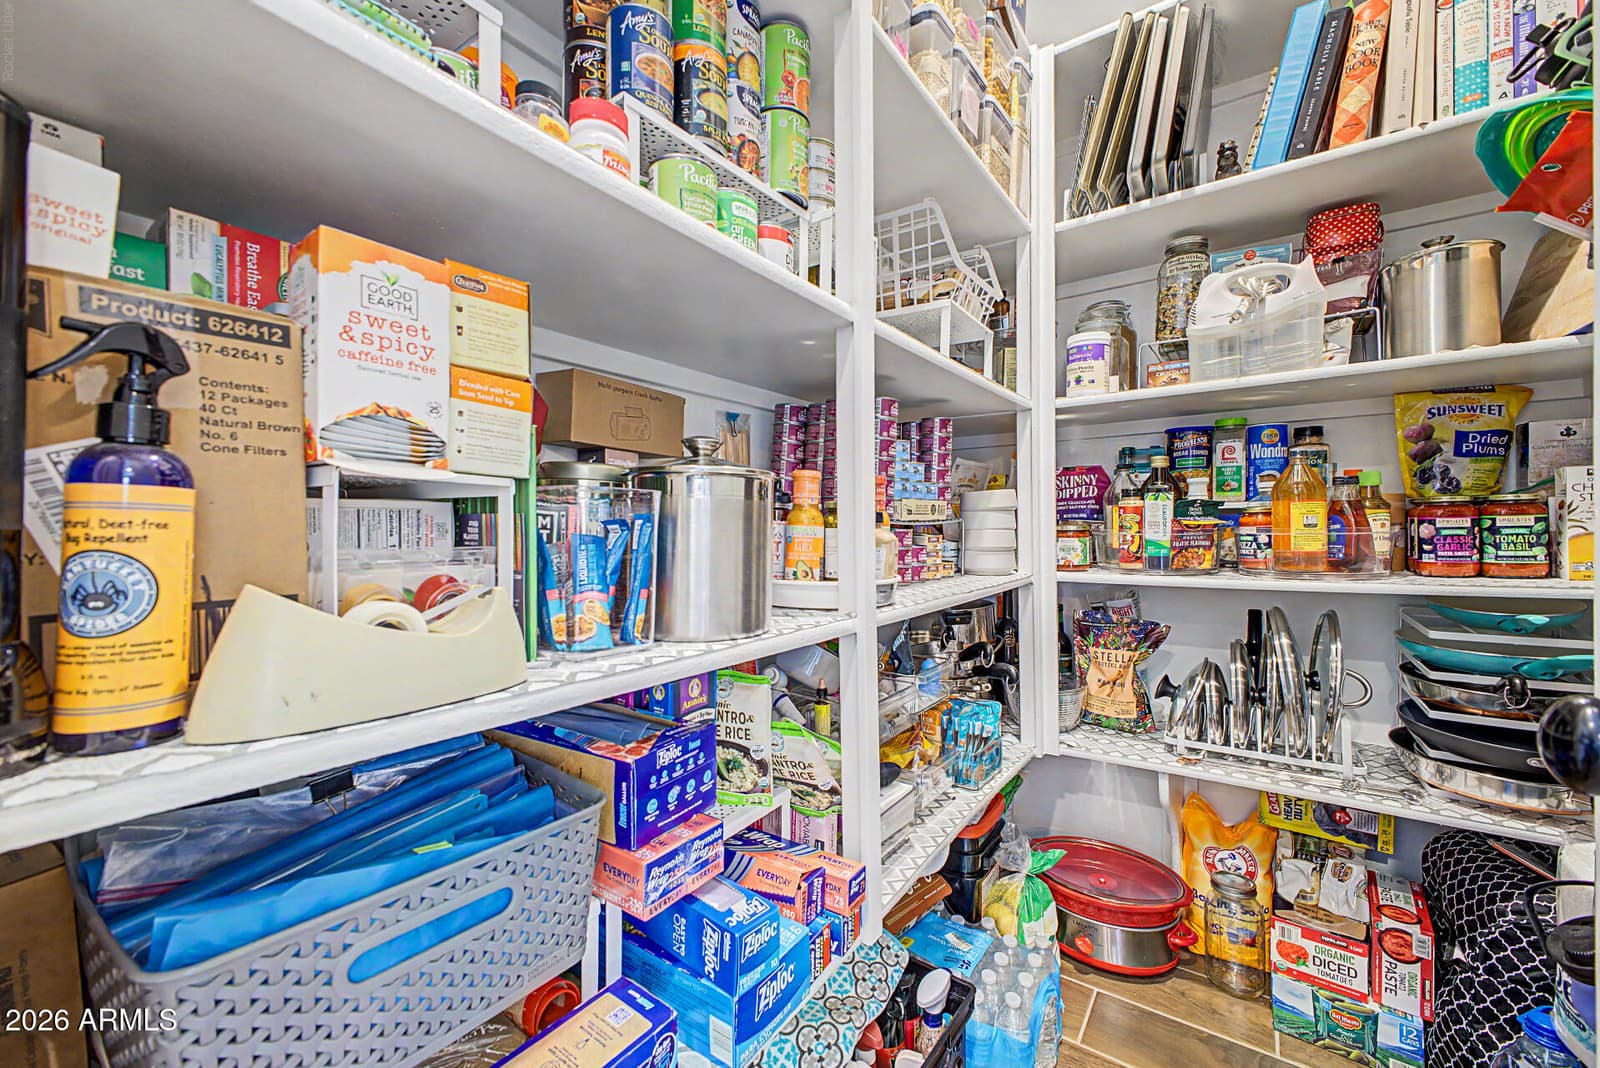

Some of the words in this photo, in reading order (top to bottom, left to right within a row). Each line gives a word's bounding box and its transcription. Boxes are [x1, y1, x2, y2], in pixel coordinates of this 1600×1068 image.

[620, 10, 656, 36] Amy's
[587, 28, 606, 38] LEN
[1321, 20, 1338, 63] MAGNOLIA
[1356, 38, 1376, 47] NEW
[570, 48, 604, 73] Amy's
[1347, 47, 1380, 63] COOK
[1345, 59, 1378, 74] BOOK
[1313, 65, 1326, 91] TABLE
[31, 221, 92, 245] original
[215, 245, 224, 284] EUCALYPTUS
[246, 242, 261, 289] Breathe
[247, 291, 261, 311] Eas
[367, 282, 413, 303] GOOD
[367, 295, 414, 315] EARTH
[91, 294, 200, 328] Product:
[208, 317, 284, 343] 626412
[348, 310, 431, 342] sweet
[177, 340, 268, 363] 437-62641
[275, 354, 284, 365] 5
[337, 348, 404, 369] caffeine
[407, 359, 437, 376] free
[199, 377, 269, 394] Contents:
[458, 378, 489, 393] Blended
[200, 391, 214, 401] 12
[221, 392, 289, 408] Packages
[200, 404, 215, 414] 40
[221, 405, 237, 416] Ct
[429, 406, 440, 415] 25
[1426, 404, 1505, 420] SUNSWEET
[200, 416, 253, 430] Natural
[258, 420, 300, 433] Brown
[201, 430, 225, 440] No.
[230, 431, 238, 441] 6
[1468, 433, 1509, 444] Dried
[200, 443, 239, 455] Cone
[244, 445, 287, 457] Filters
[1463, 444, 1505, 456] Plums
[1056, 474, 1098, 489] SKINNY
[99, 519, 170, 530] Deet-free
[84, 533, 148, 545] Repellent
[1240, 541, 1257, 549] IZZA
[1436, 543, 1472, 551] GARLIC
[1495, 535, 1536, 543] TOMATO
[1501, 543, 1531, 551] BASIL
[717, 710, 746, 724] NTRO
[725, 726, 751, 740] RICE
[657, 744, 683, 769] Ziploc
[772, 759, 805, 770] ANTRO
[790, 770, 816, 781] RICE
[1283, 795, 1293, 821] HEAV
[692, 828, 723, 851] Reynolds
[745, 830, 786, 849] Wrap
[650, 853, 685, 881] Reynolds
[819, 854, 855, 869] EVERYDAY
[603, 862, 640, 888] EVERYDAY
[757, 868, 792, 887] EVERYDAY
[649, 889, 683, 915] EVERYDAY
[672, 914, 681, 953] OPEN
[743, 921, 778, 957] Ziploc
[703, 926, 719, 982] Ziploc
[1315, 945, 1355, 965] ORGANIC
[1313, 955, 1357, 978] DICED
[1317, 968, 1353, 986] TOMATOES
[1384, 960, 1397, 996] PASTE
[1399, 973, 1407, 991] TOMATO
[1407, 971, 1418, 999] ORGANIC
[756, 964, 796, 1016] Ziploc
[1403, 1025, 1419, 1040] 12
[1403, 1038, 1420, 1047] CANS
